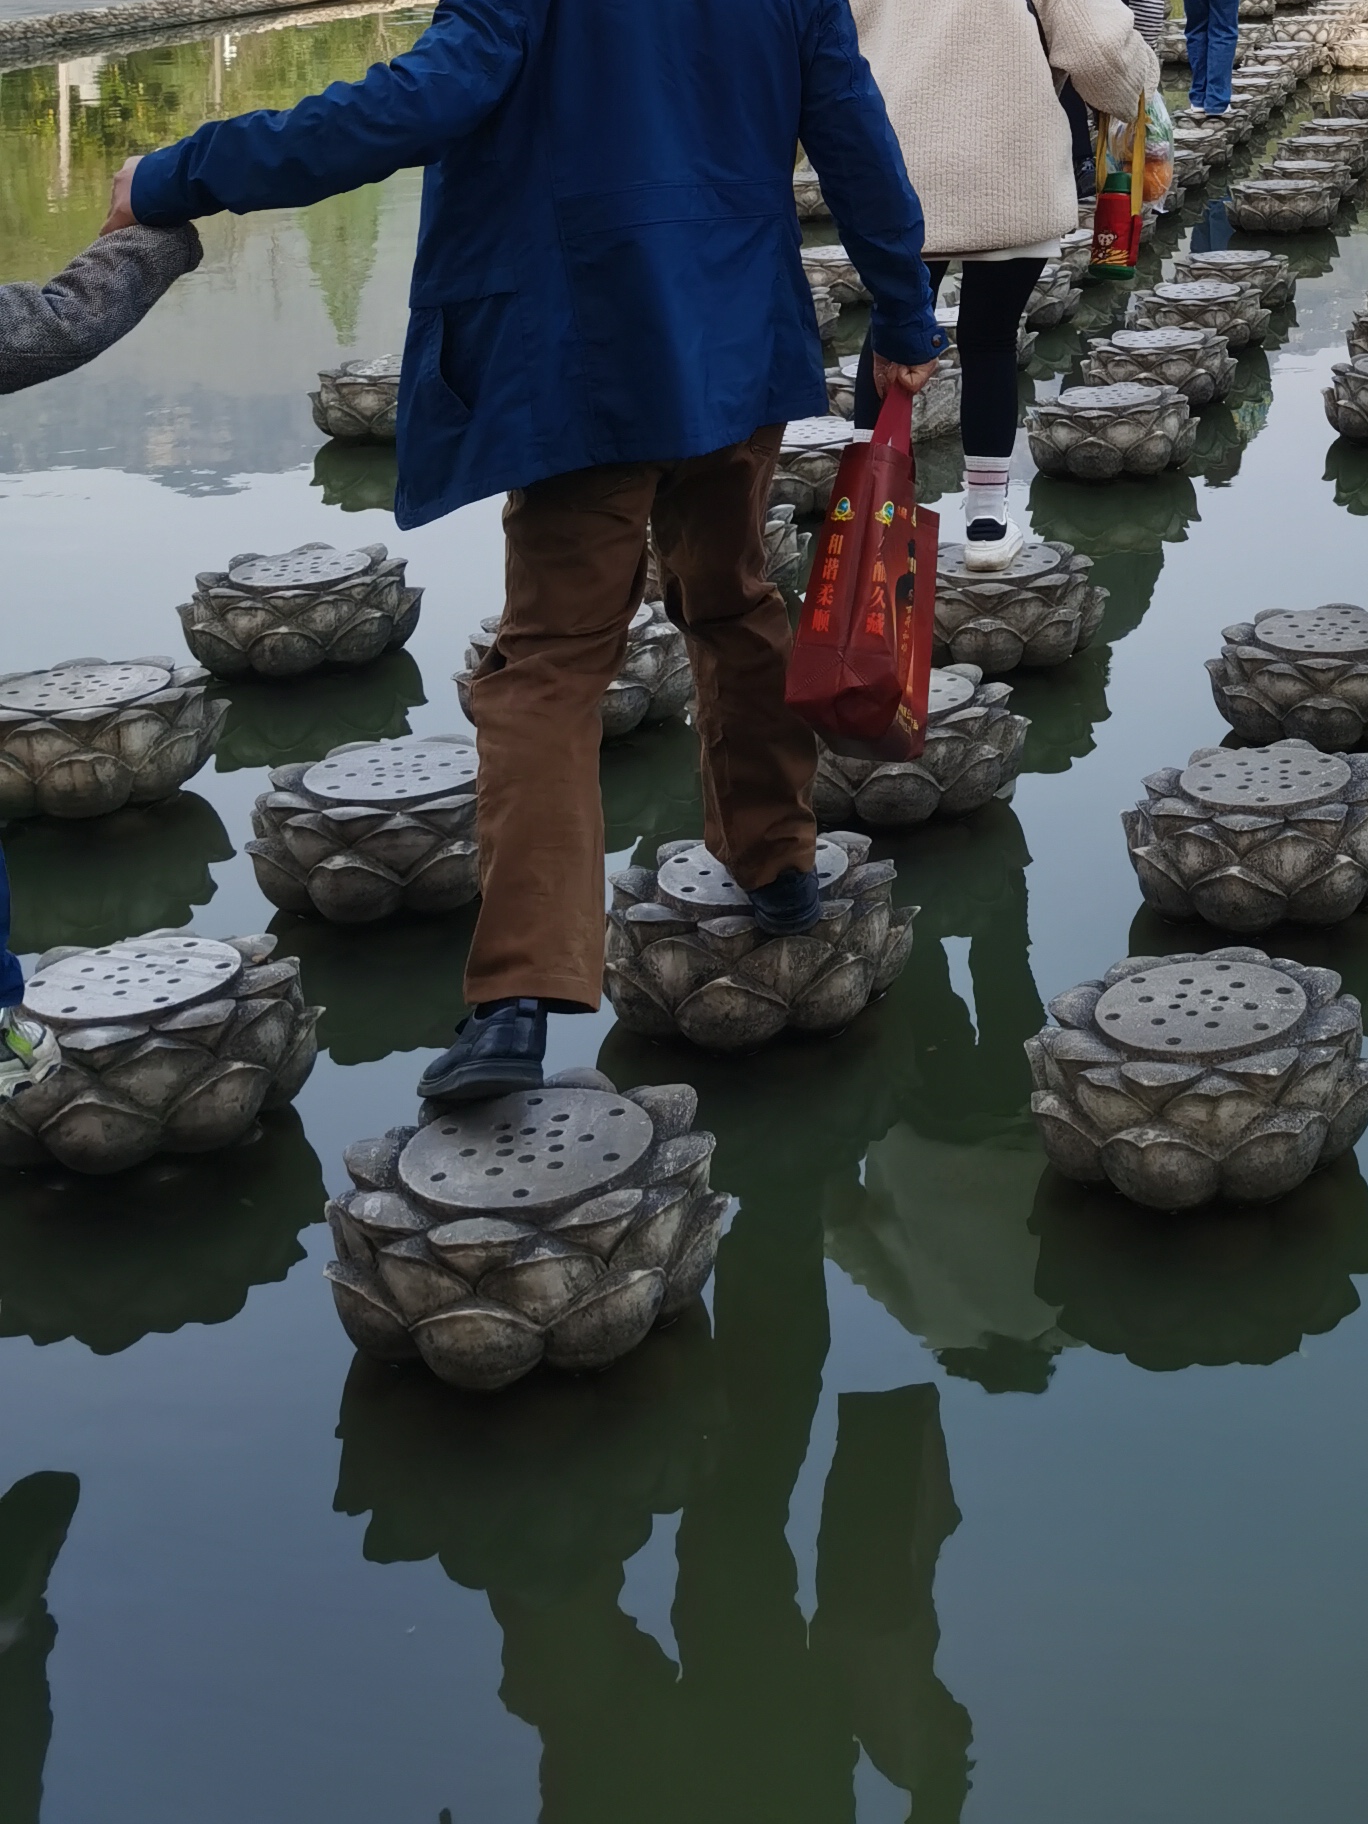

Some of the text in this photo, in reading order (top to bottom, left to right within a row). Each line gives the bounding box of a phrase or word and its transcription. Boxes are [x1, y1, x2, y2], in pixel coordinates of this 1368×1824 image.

[812, 533, 844, 632] 和谐柔顺
[865, 560, 887, 635] 酿久藏
